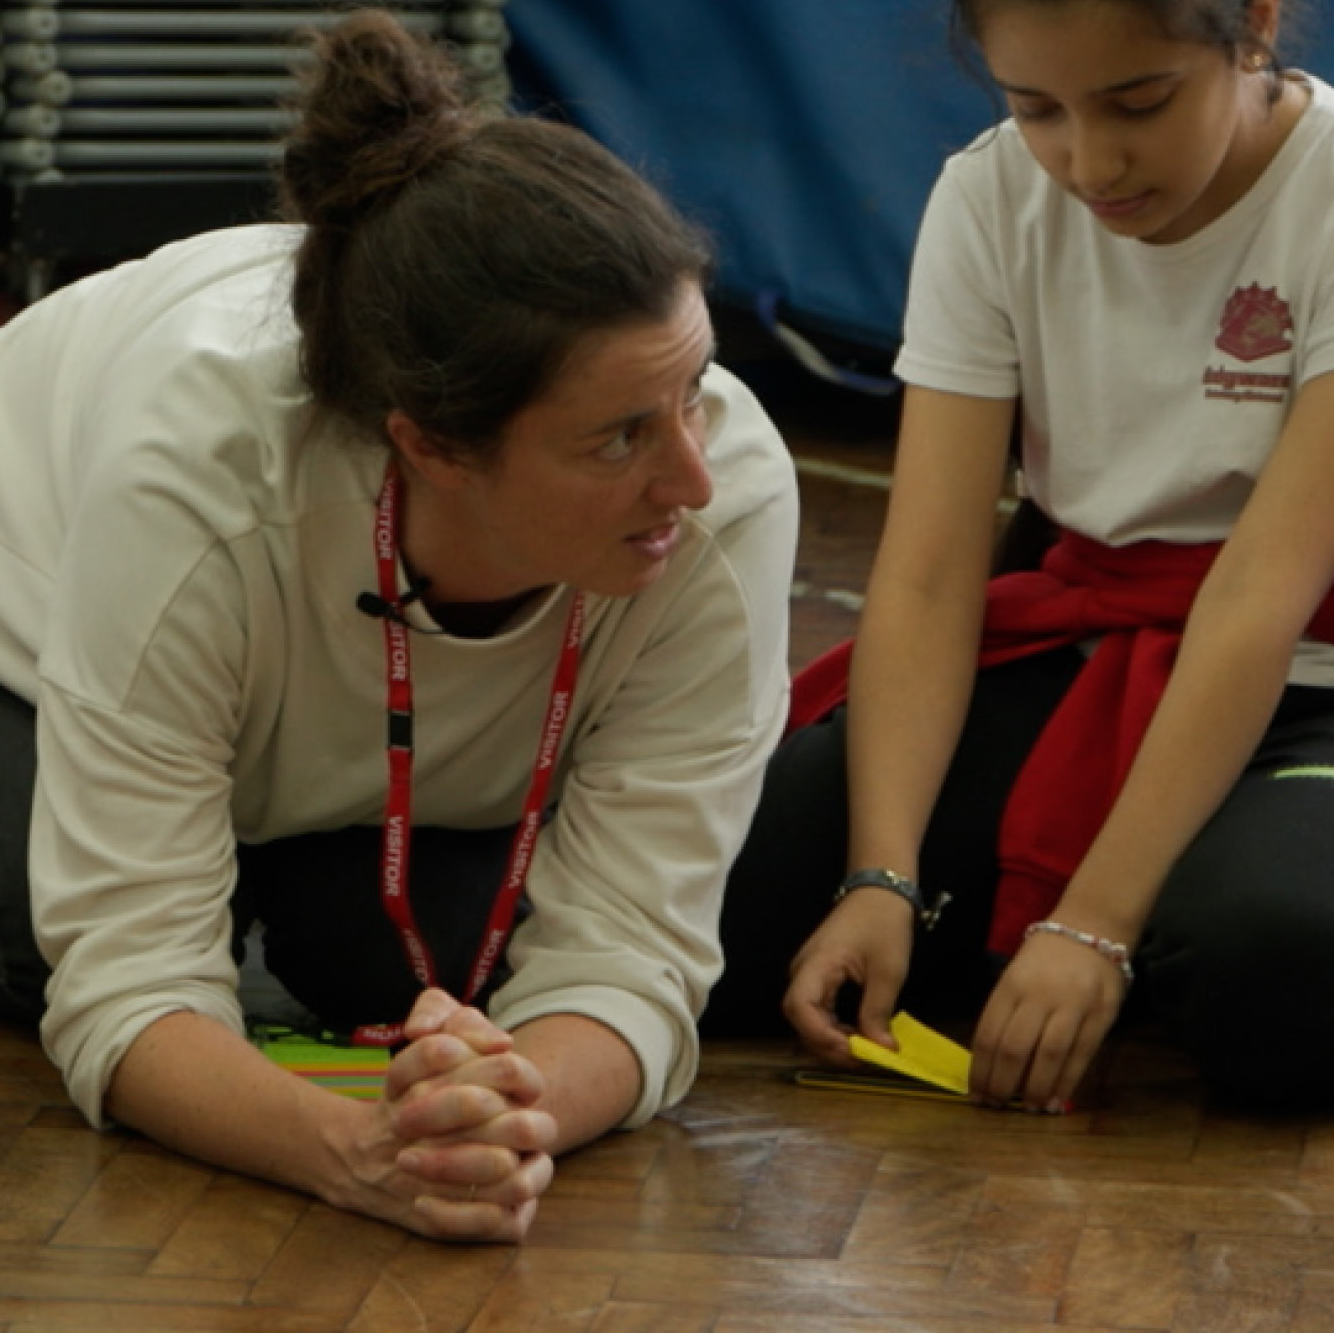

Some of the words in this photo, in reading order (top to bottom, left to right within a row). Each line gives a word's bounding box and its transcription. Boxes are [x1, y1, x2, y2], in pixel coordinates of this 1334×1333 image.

[538, 691, 567, 768] VISITOR
[384, 814, 404, 897] VISITOR
[508, 812, 540, 889] VISITOR
